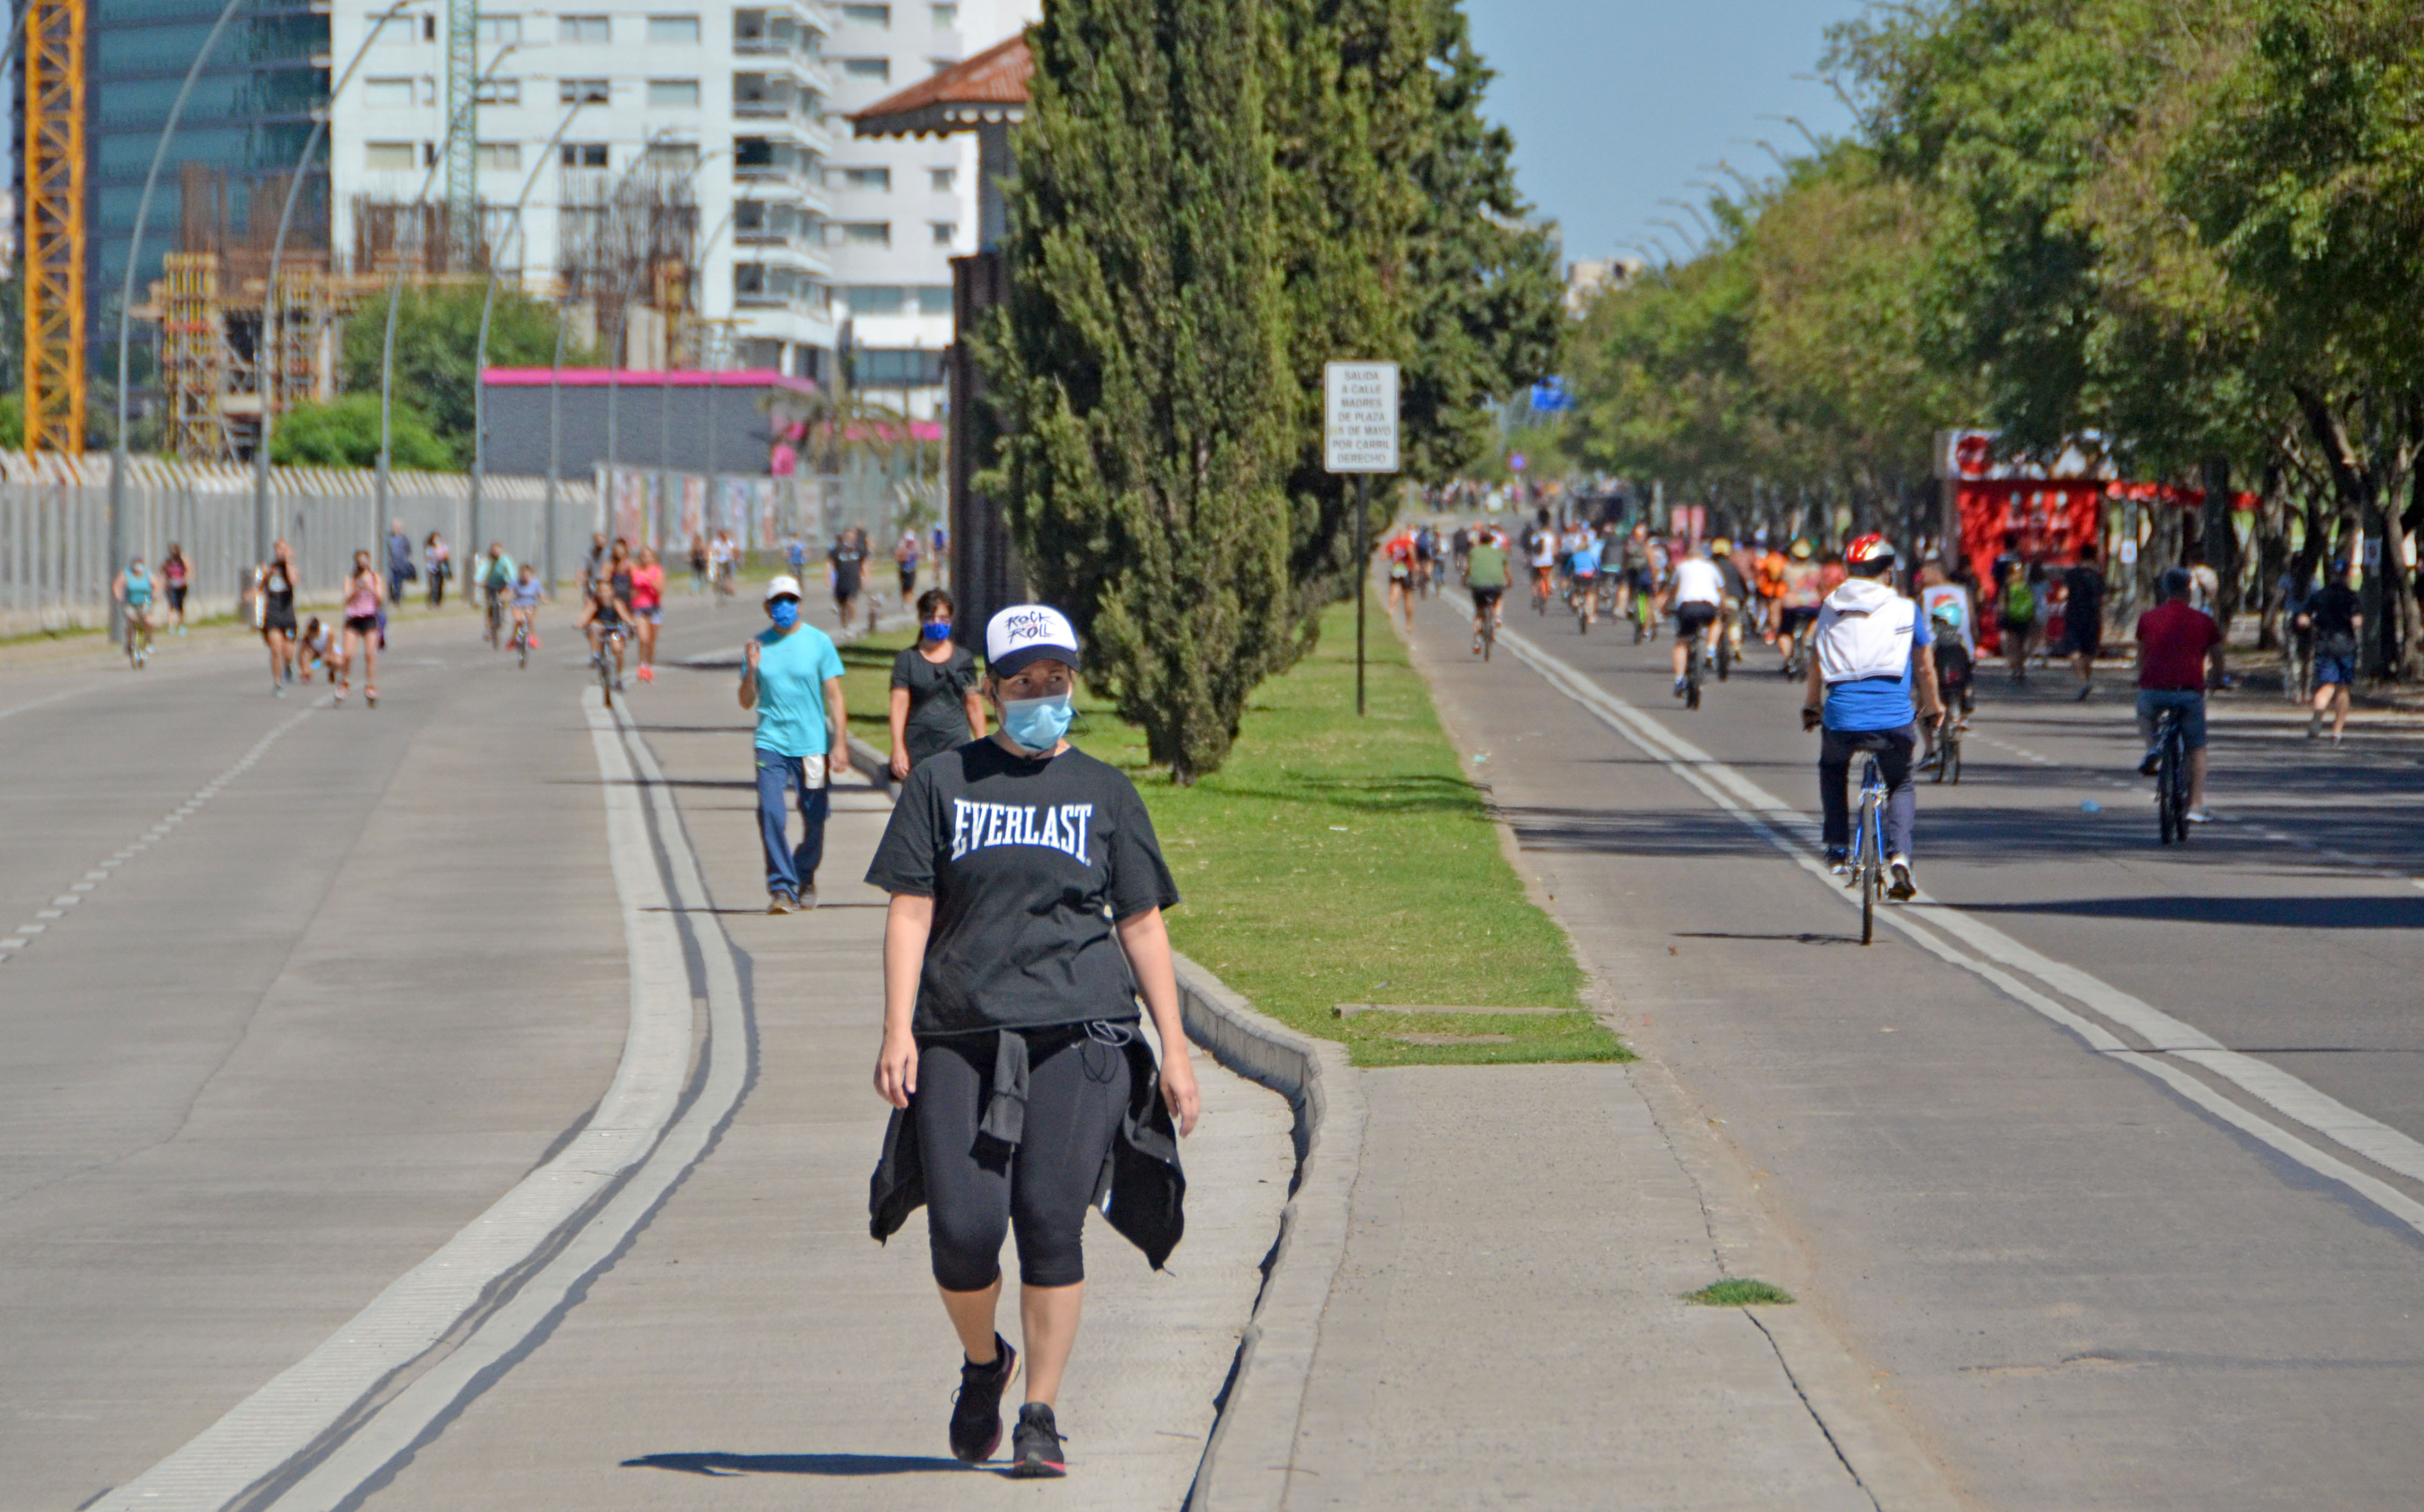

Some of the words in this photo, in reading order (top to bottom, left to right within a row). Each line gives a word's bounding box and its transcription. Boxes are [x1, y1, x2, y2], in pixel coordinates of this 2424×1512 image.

[1344, 371, 1379, 381] SALIDA
[1342, 384, 1348, 394] A
[1351, 384, 1381, 394] CALLE
[1341, 398, 1382, 408] MADRES
[1338, 412, 1351, 422] DE
[1355, 412, 1385, 421] PLAZA
[1348, 426, 1360, 436] DE
[1364, 426, 1391, 436] MAYO
[1333, 440, 1353, 450] POR
[1356, 439, 1391, 450] CARRIL
[1338, 454, 1386, 464] DERECHO
[1005, 611, 1056, 629] ROCK
[1008, 623, 1055, 644] ROLL
[951, 798, 1092, 864] EVERLAST
